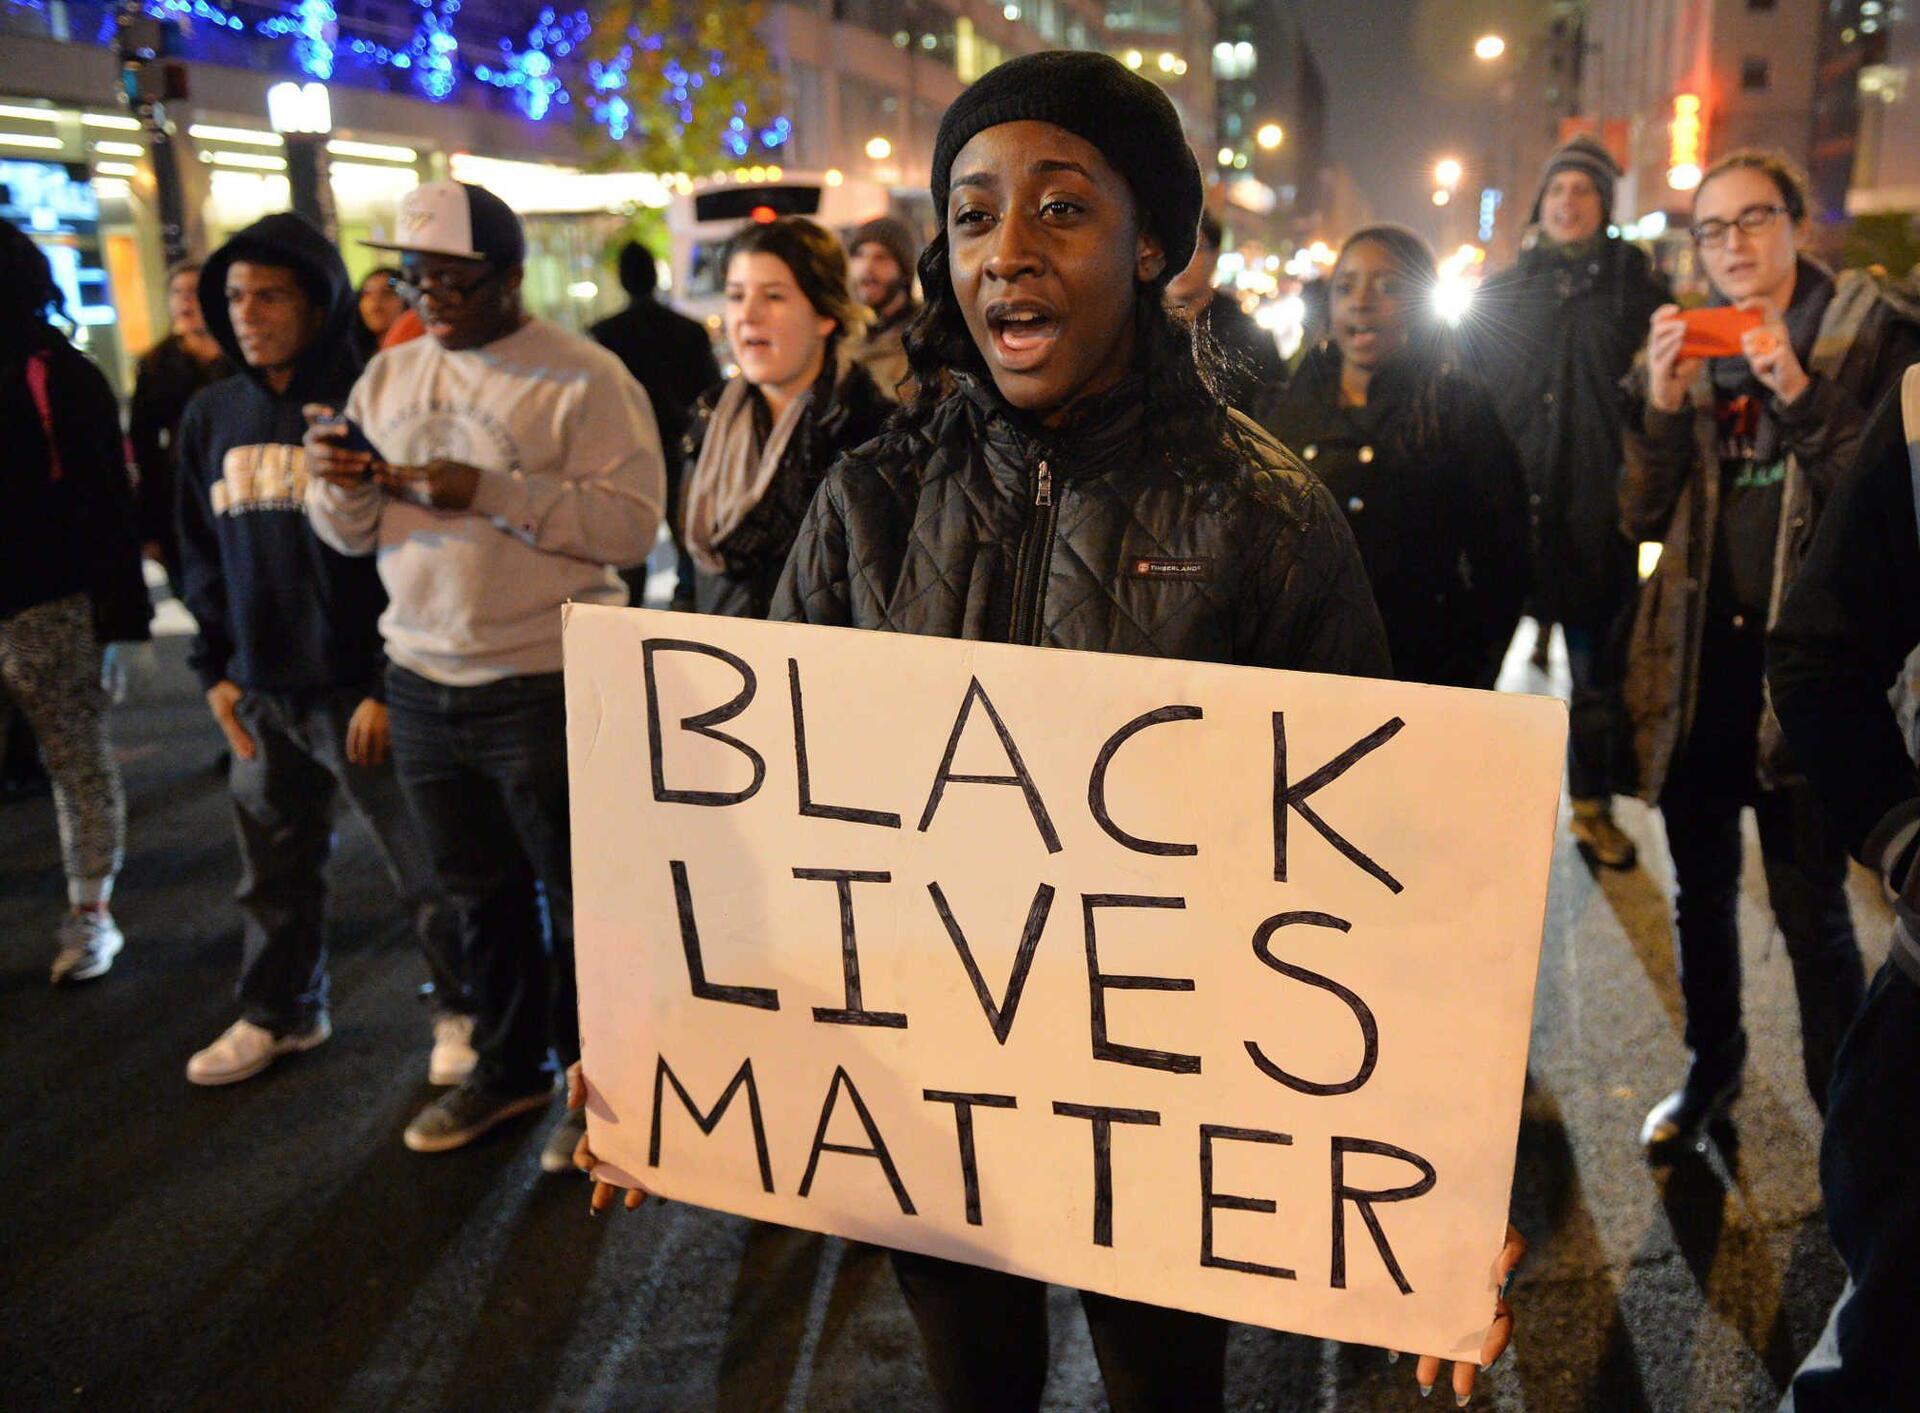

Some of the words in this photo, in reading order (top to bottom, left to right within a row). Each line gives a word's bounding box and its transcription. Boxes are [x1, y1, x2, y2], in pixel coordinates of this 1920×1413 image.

[642, 638, 1405, 895] BLACK
[669, 860, 1379, 1097] LIVES
[648, 1053, 1437, 1296] MATTER
